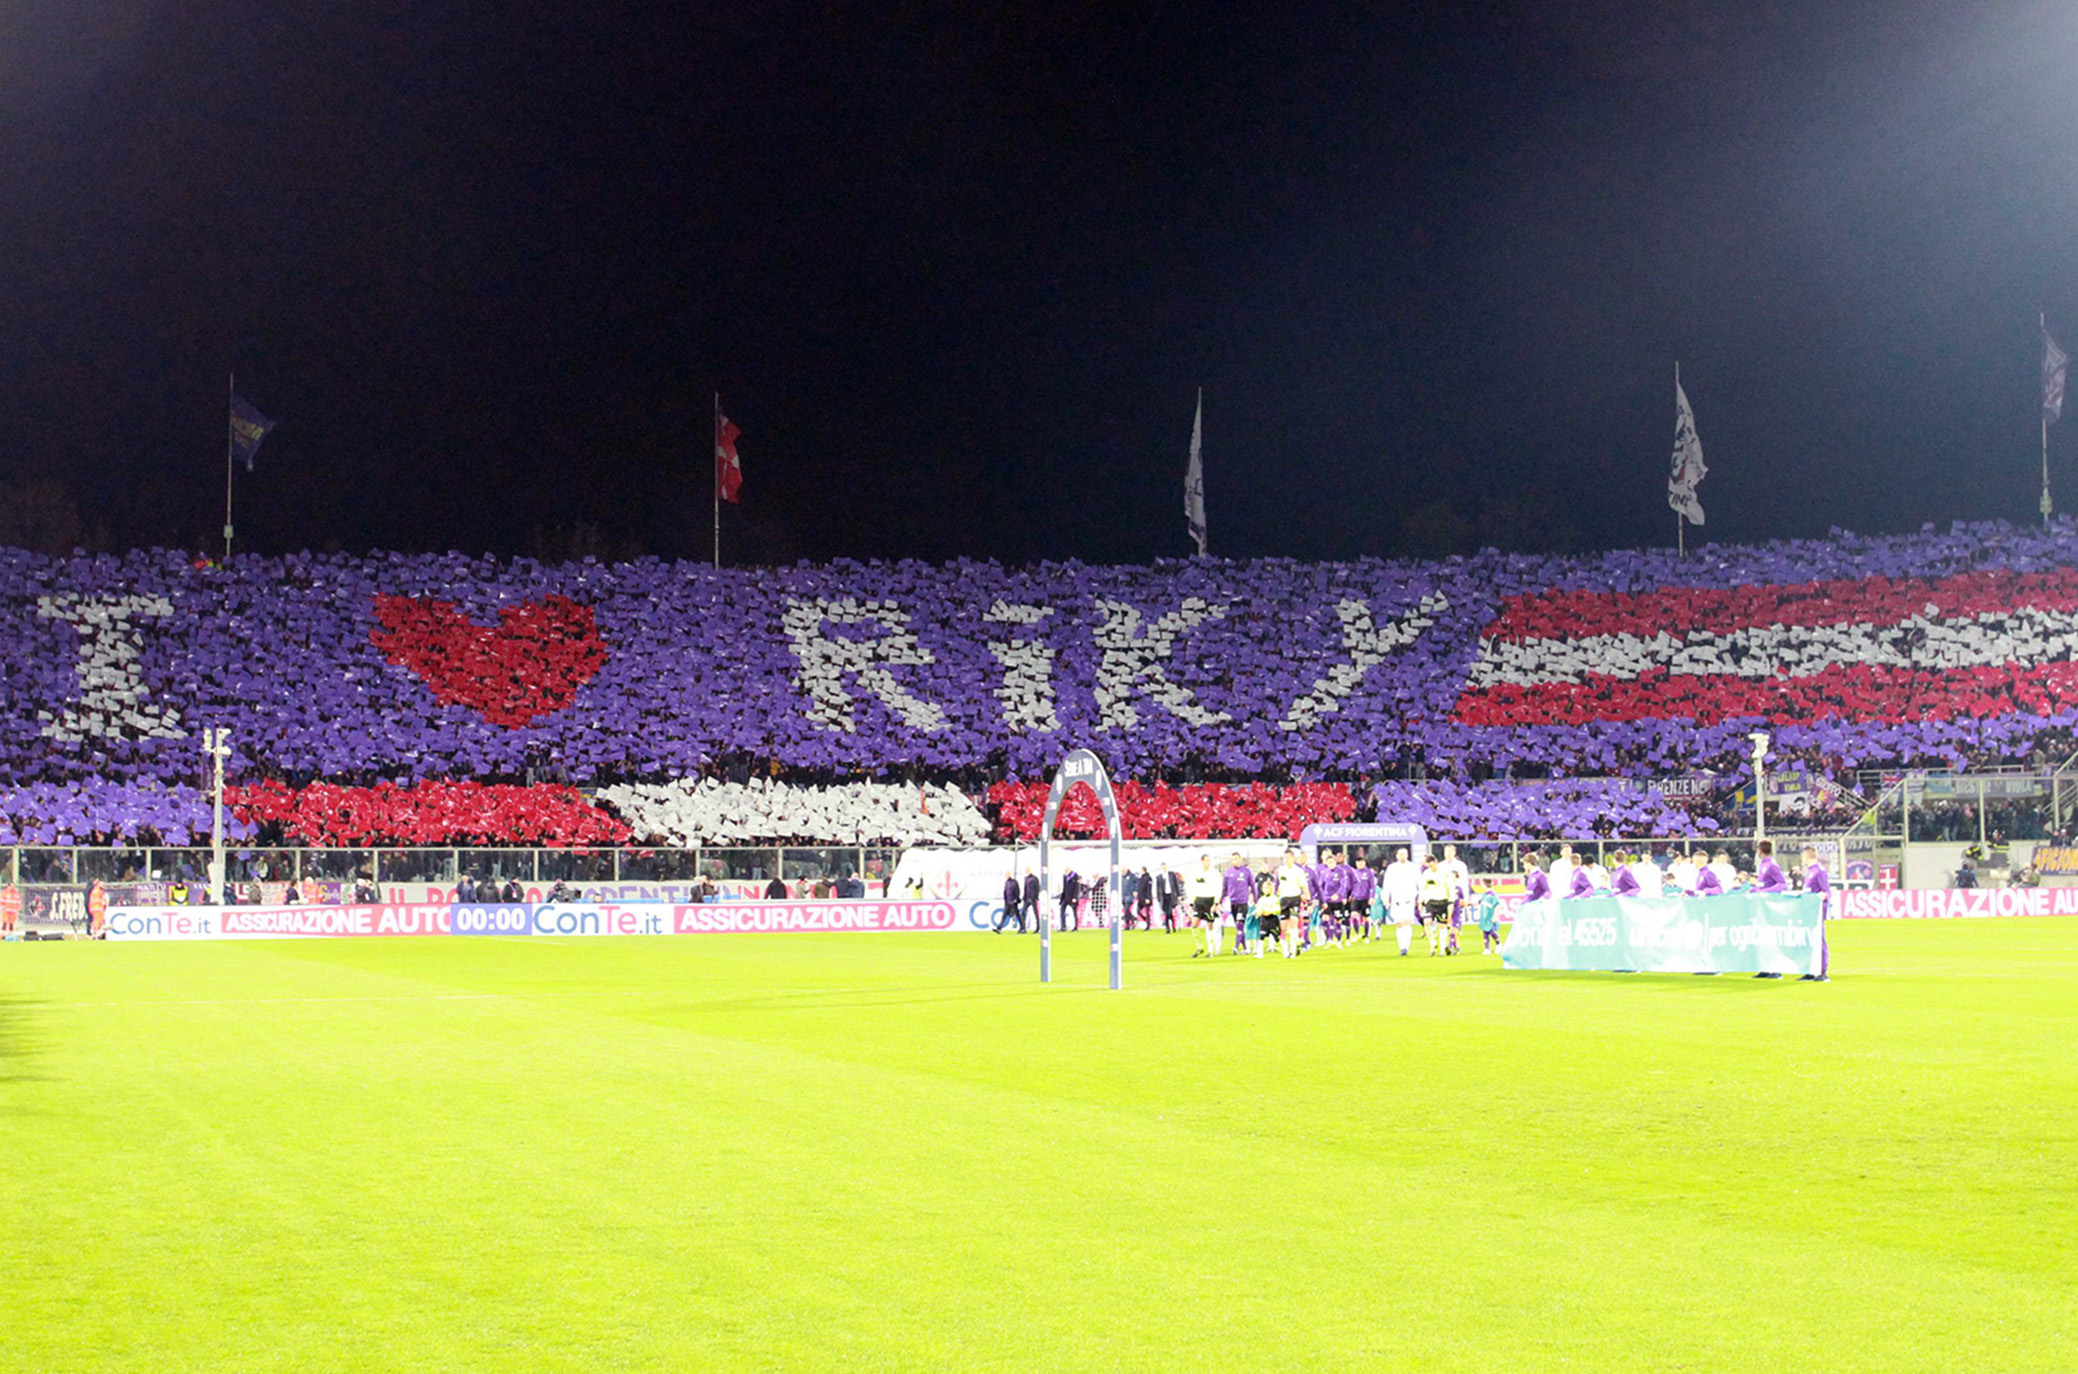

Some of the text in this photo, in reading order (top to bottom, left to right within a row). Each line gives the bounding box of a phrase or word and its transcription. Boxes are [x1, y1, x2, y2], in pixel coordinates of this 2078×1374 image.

[38, 593, 186, 741] I
[1323, 826, 1408, 838] ACF FIORENTINA
[680, 905, 879, 931] ASSICURAZIONE
[883, 904, 950, 928] AUTO
[1844, 889, 2050, 919] ASSICURAZIONE
[110, 912, 212, 935] ConTe.it
[226, 908, 373, 934] ASSICURAZIONE
[457, 908, 526, 931] 00:00
[533, 905, 663, 934] ConTe.it
[1574, 917, 1618, 946] 45525
